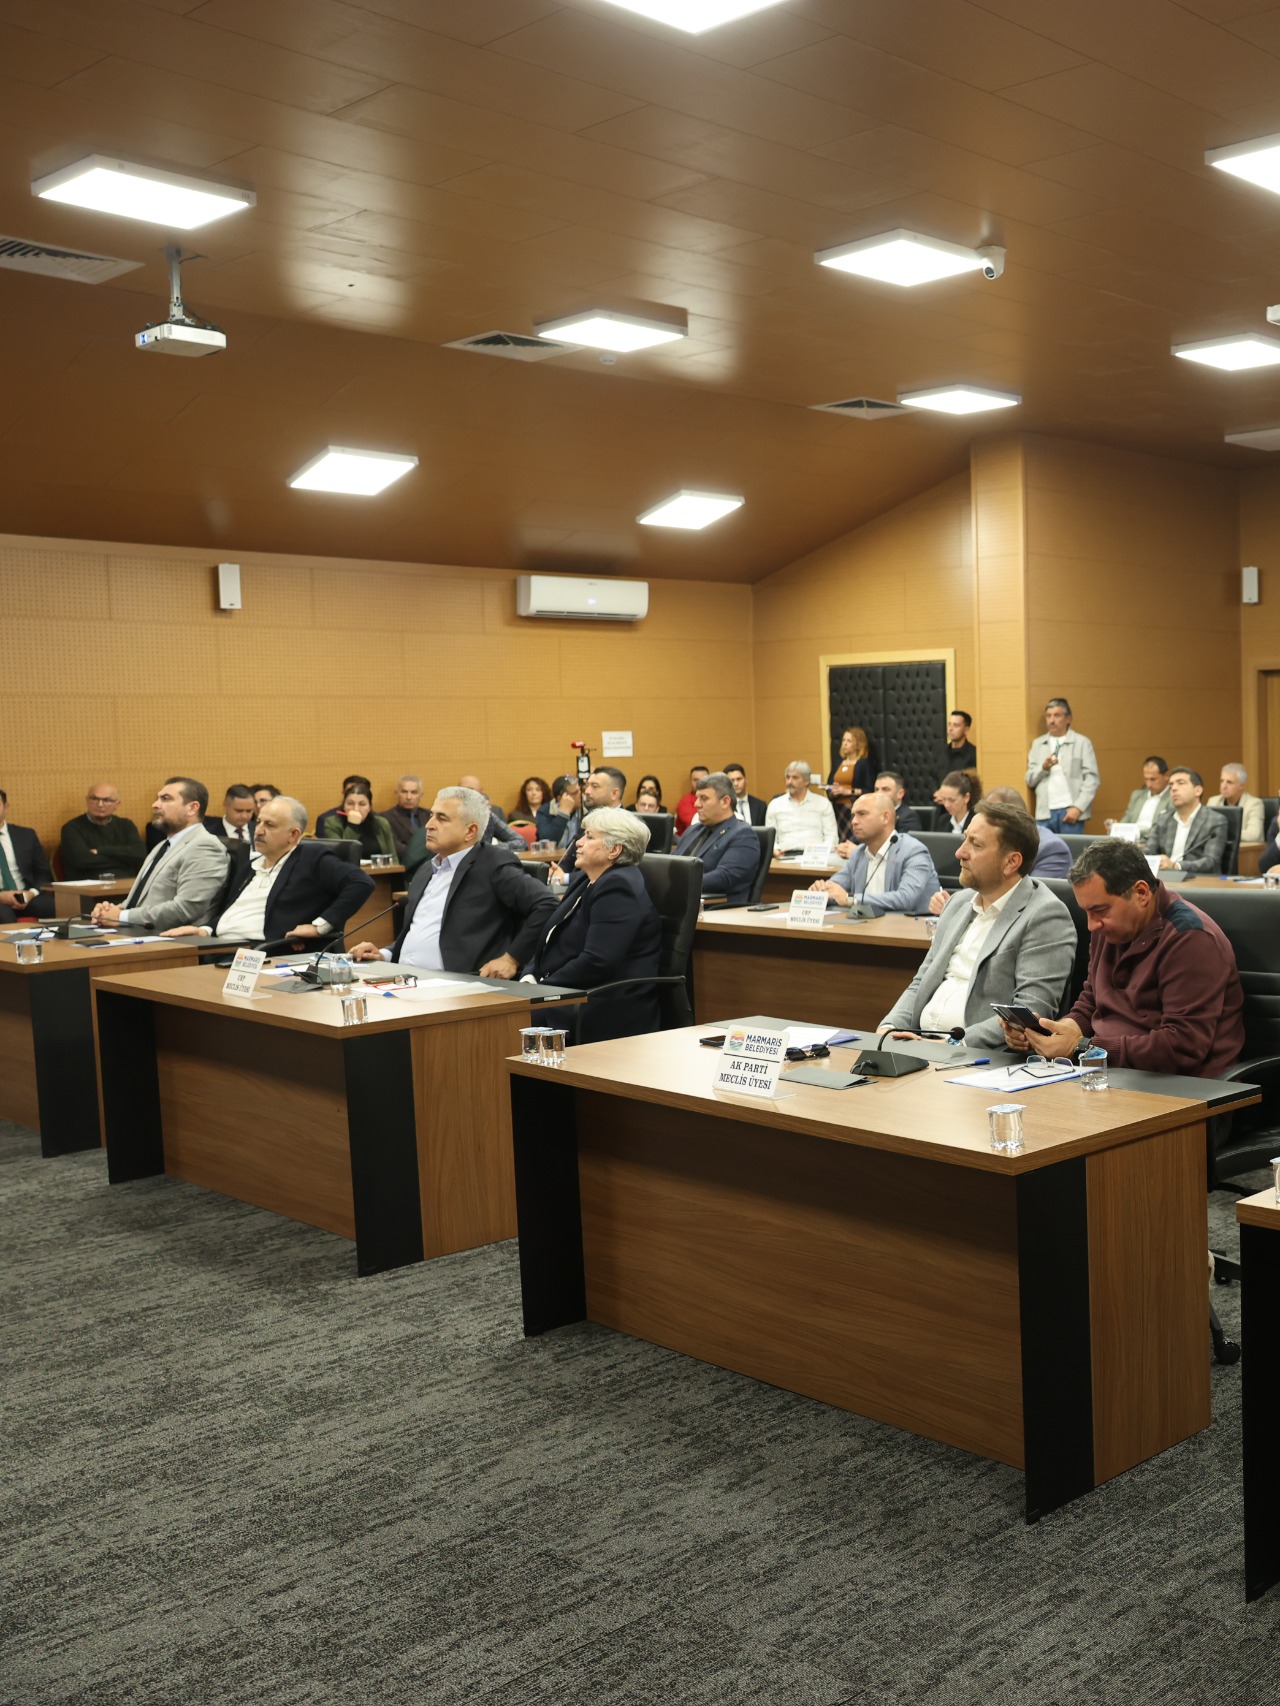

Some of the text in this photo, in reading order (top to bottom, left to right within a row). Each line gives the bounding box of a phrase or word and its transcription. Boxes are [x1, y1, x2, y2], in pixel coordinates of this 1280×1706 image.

[730, 1060, 768, 1074] AK PARTİ
[719, 1073, 772, 1090] MECLİS ÜYESİ
